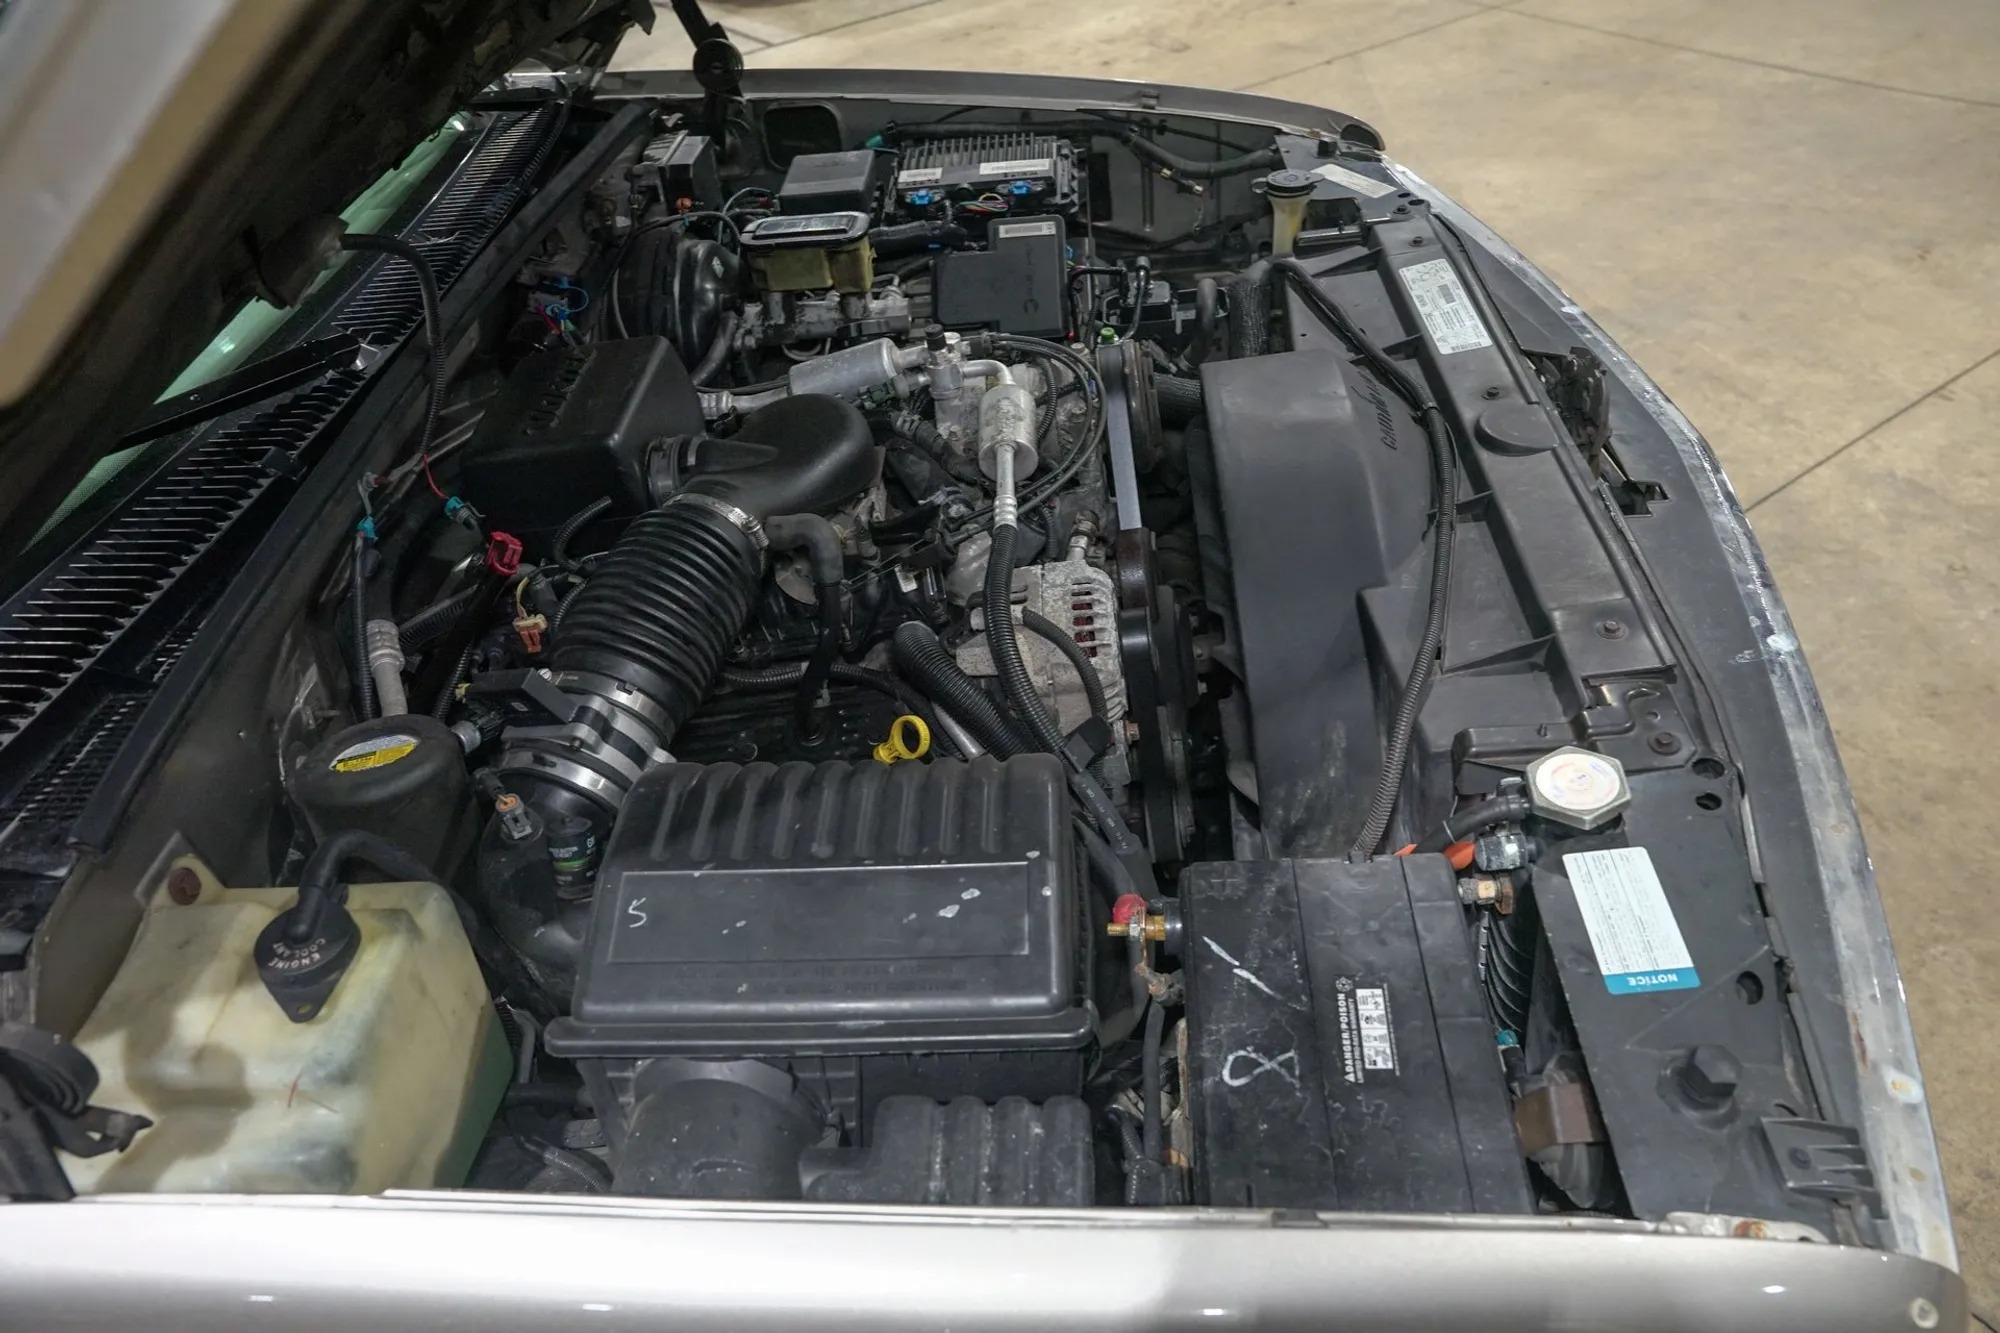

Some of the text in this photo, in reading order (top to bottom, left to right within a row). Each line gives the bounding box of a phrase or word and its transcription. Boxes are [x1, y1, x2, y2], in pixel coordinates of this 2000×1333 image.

[273, 938, 325, 957] COOLANT
[268, 952, 320, 968] ENGINE
[1626, 973, 1679, 987] NOTICE
[1337, 993, 1354, 1073] DANGER/POISON
